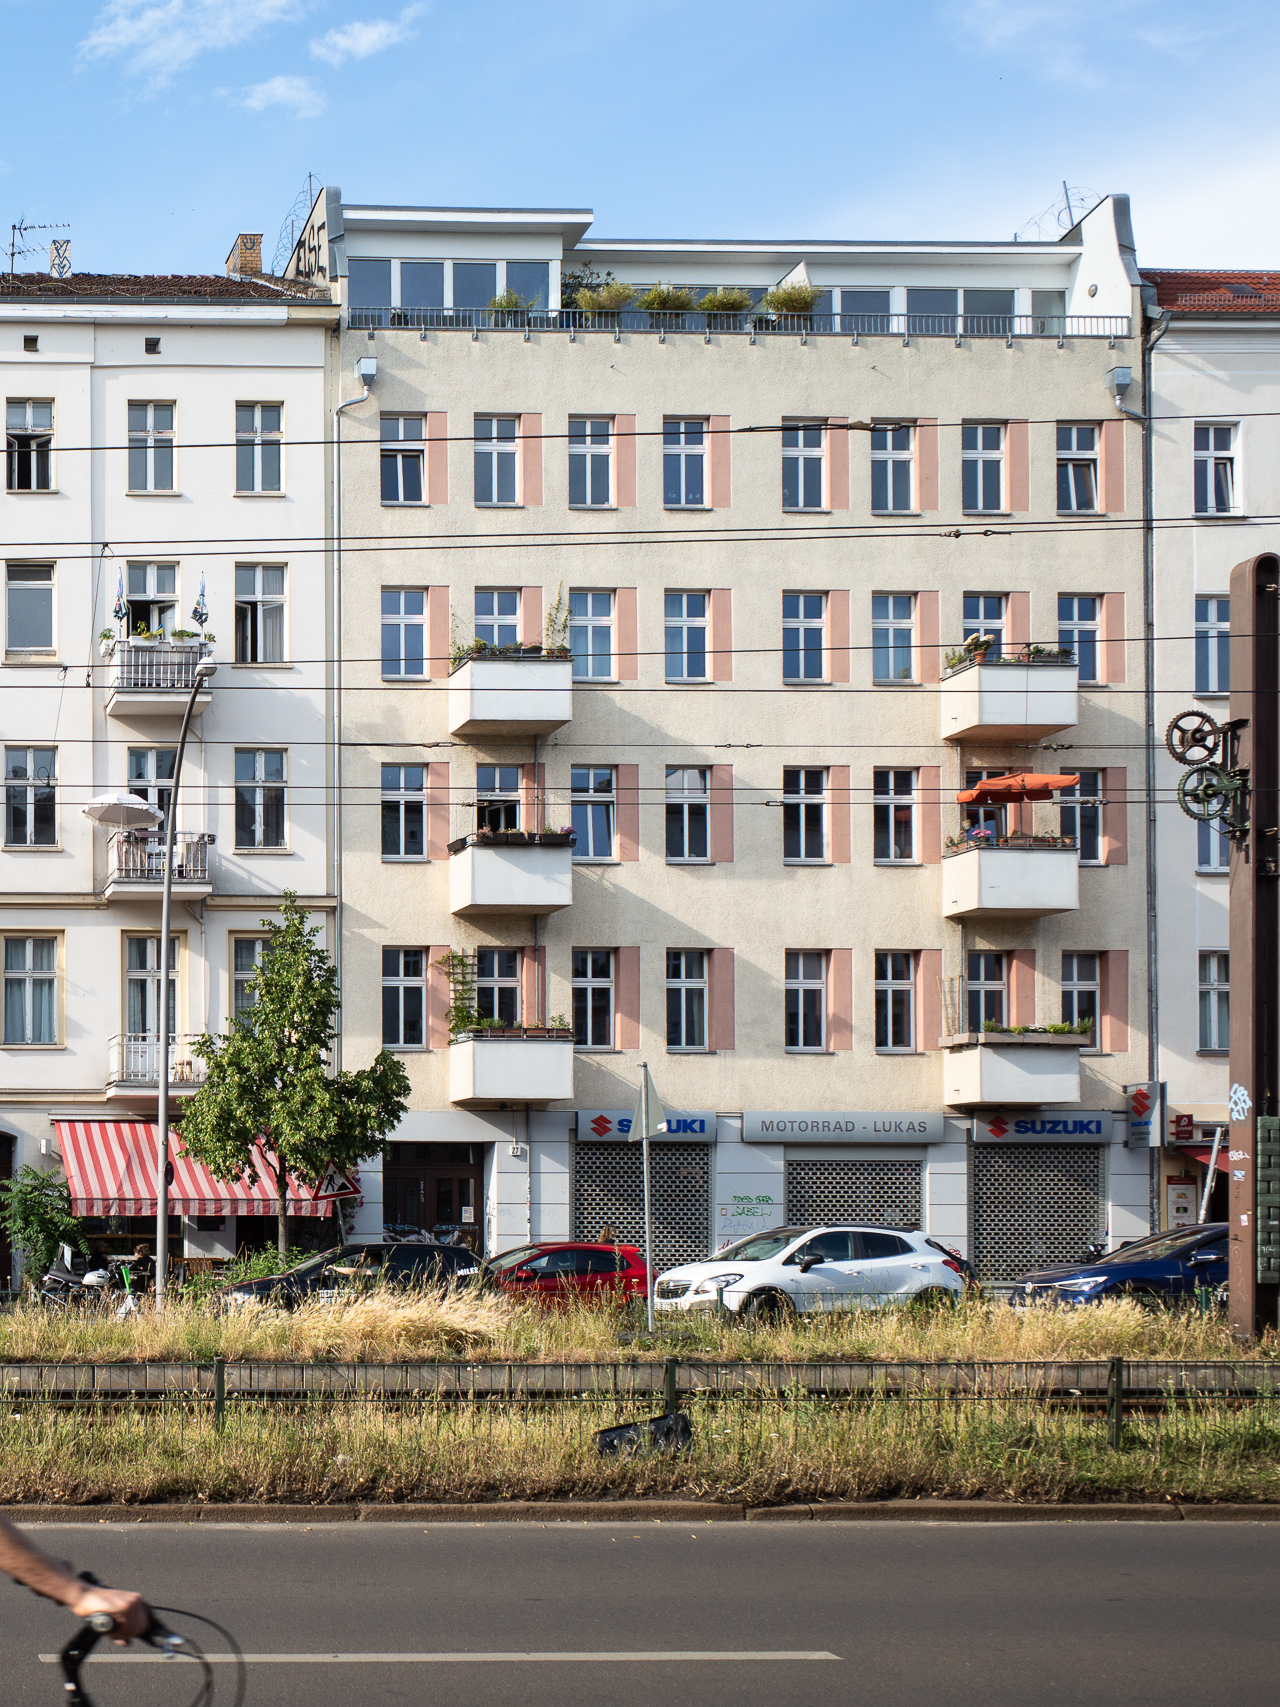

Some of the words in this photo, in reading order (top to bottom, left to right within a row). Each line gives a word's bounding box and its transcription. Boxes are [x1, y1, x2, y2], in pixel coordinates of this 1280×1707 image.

[617, 1118, 706, 1134] SUKI
[760, 1120, 856, 1133] MOTORRAD
[873, 1120, 928, 1133] LUKAS
[1014, 1119, 1102, 1135] SUZUKI
[456, 1266, 479, 1277] MILES
